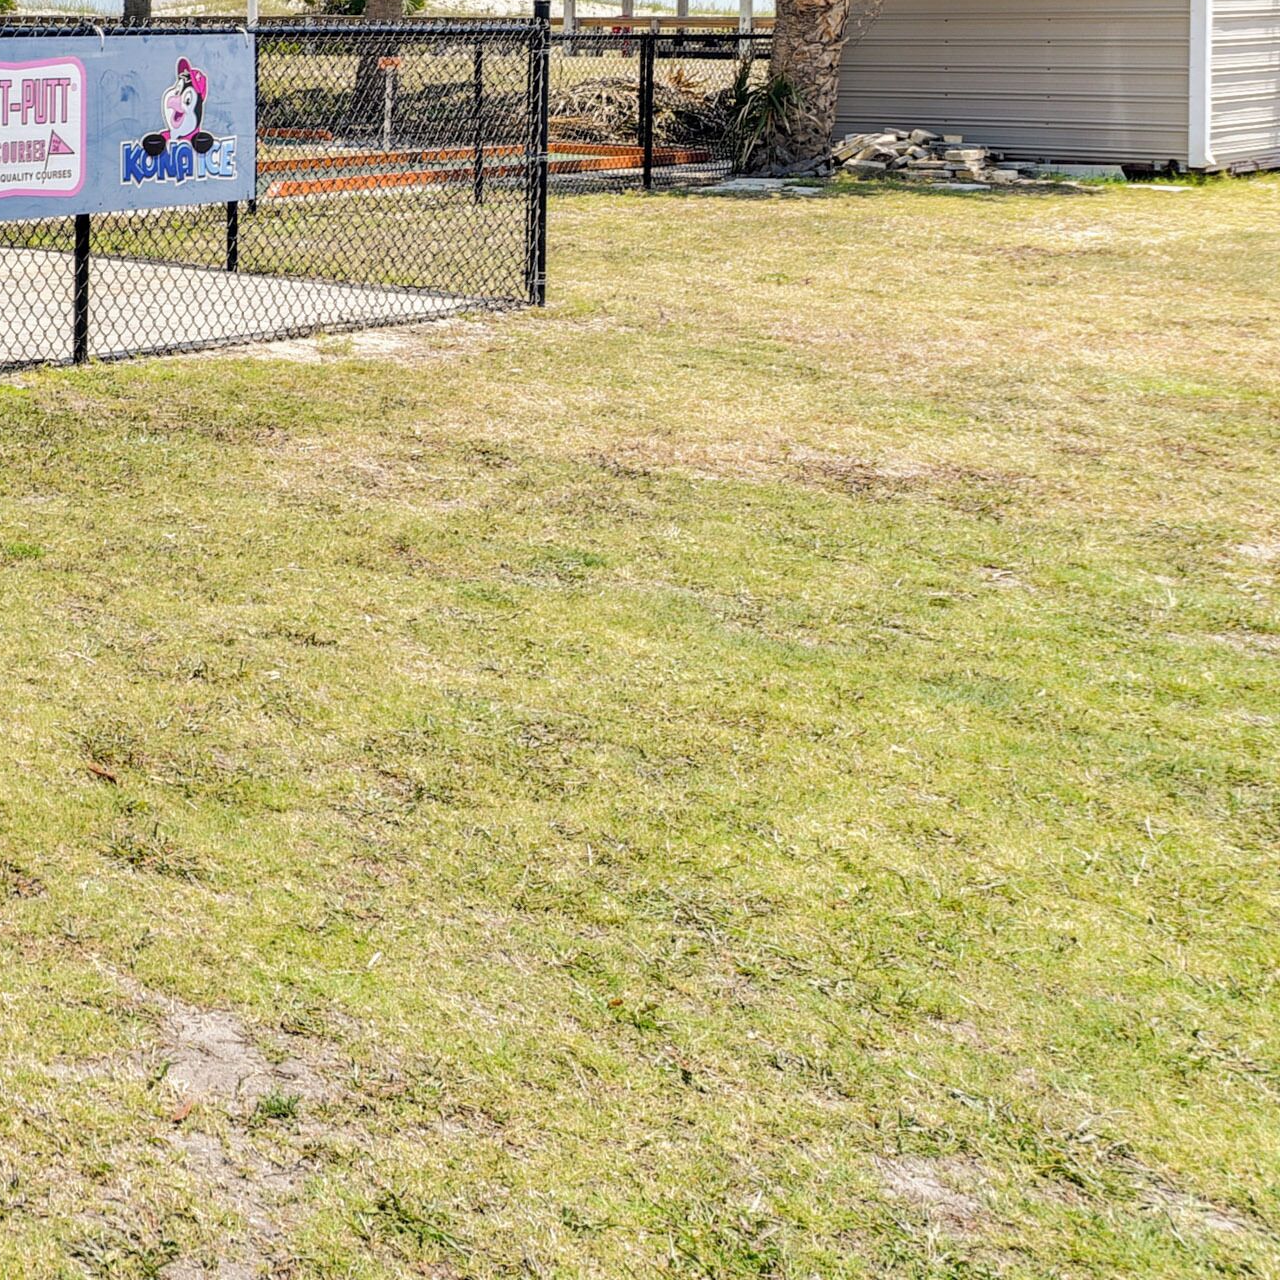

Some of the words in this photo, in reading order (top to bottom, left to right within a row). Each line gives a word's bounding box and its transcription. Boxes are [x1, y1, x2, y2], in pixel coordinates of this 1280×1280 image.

[0, 172, 33, 184] QUALITY
[35, 169, 72, 181] COURSES
[122, 141, 194, 184] KONA
[197, 139, 236, 178] ICE
